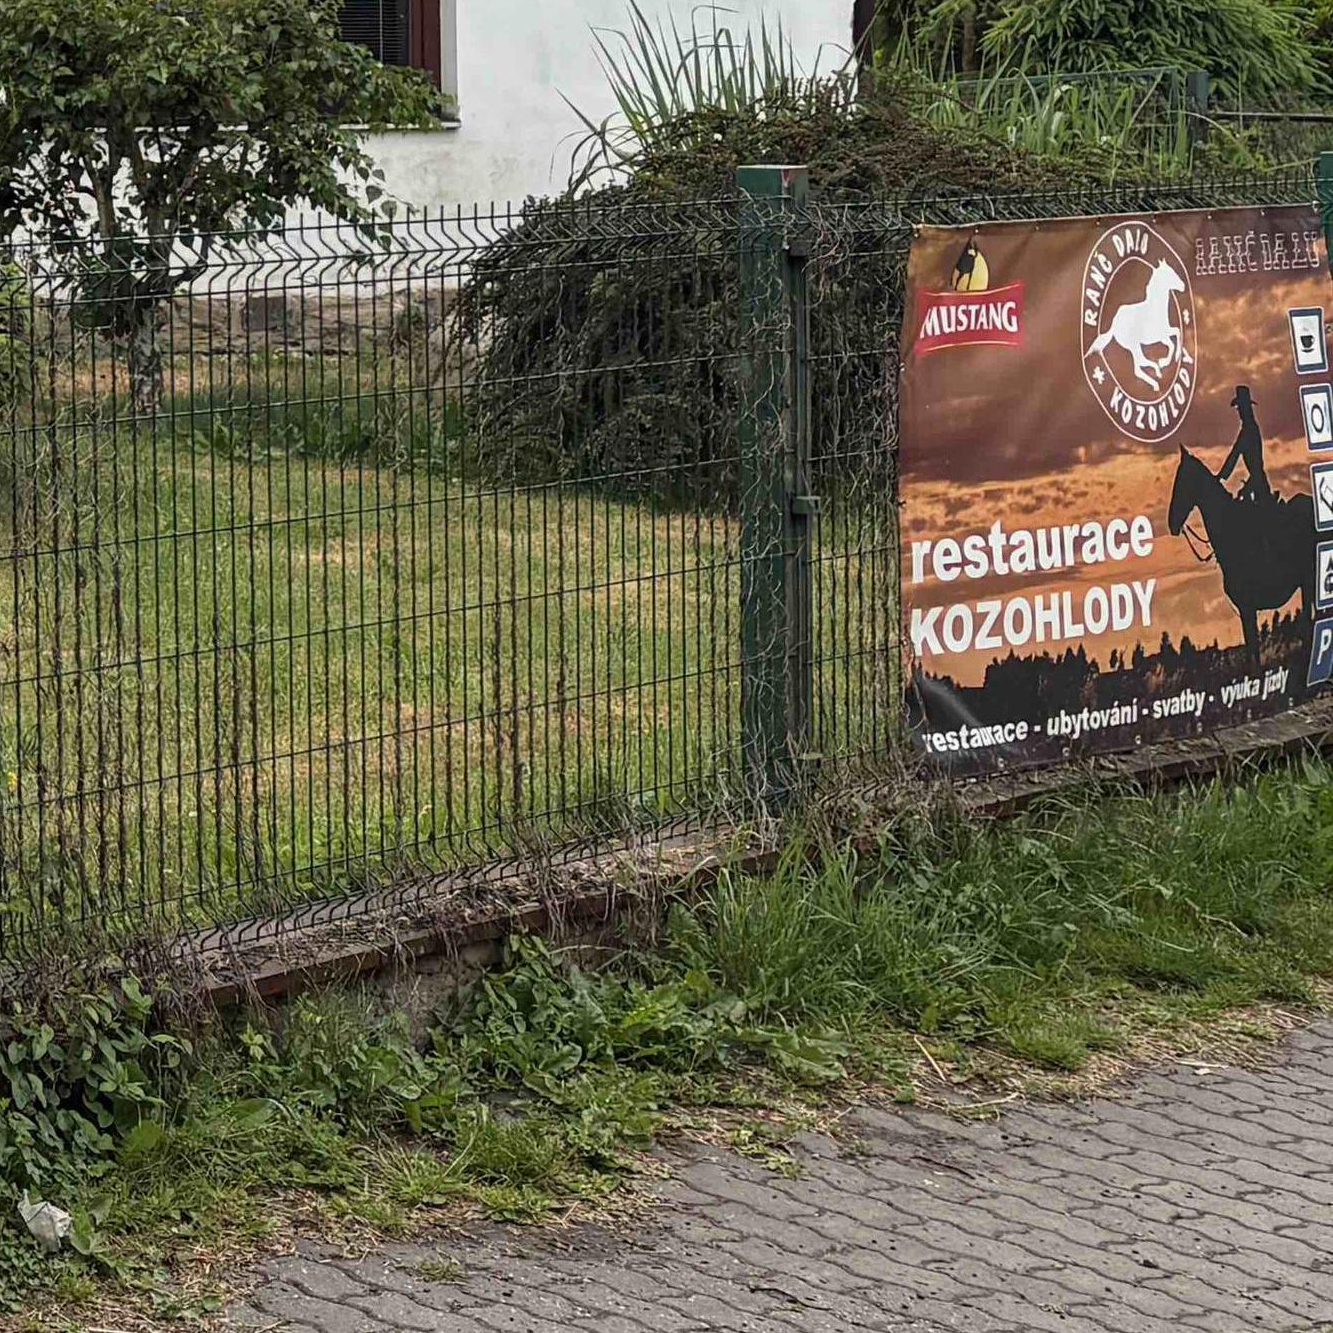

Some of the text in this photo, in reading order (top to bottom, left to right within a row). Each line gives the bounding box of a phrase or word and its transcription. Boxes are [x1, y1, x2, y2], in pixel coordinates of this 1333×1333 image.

[919, 301, 1019, 339] MUSTANG
[1084, 250, 1113, 327] RANČ
[1110, 346, 1194, 431] KOZOHLODY
[911, 515, 1154, 584] restaurace
[910, 578, 1156, 657] KOZOHLODY
[1316, 628, 1332, 666] P
[922, 720, 1029, 753] restaurace
[1047, 697, 1139, 740] ubytování
[1152, 689, 1206, 719] svatby
[1220, 676, 1260, 709] výuka
